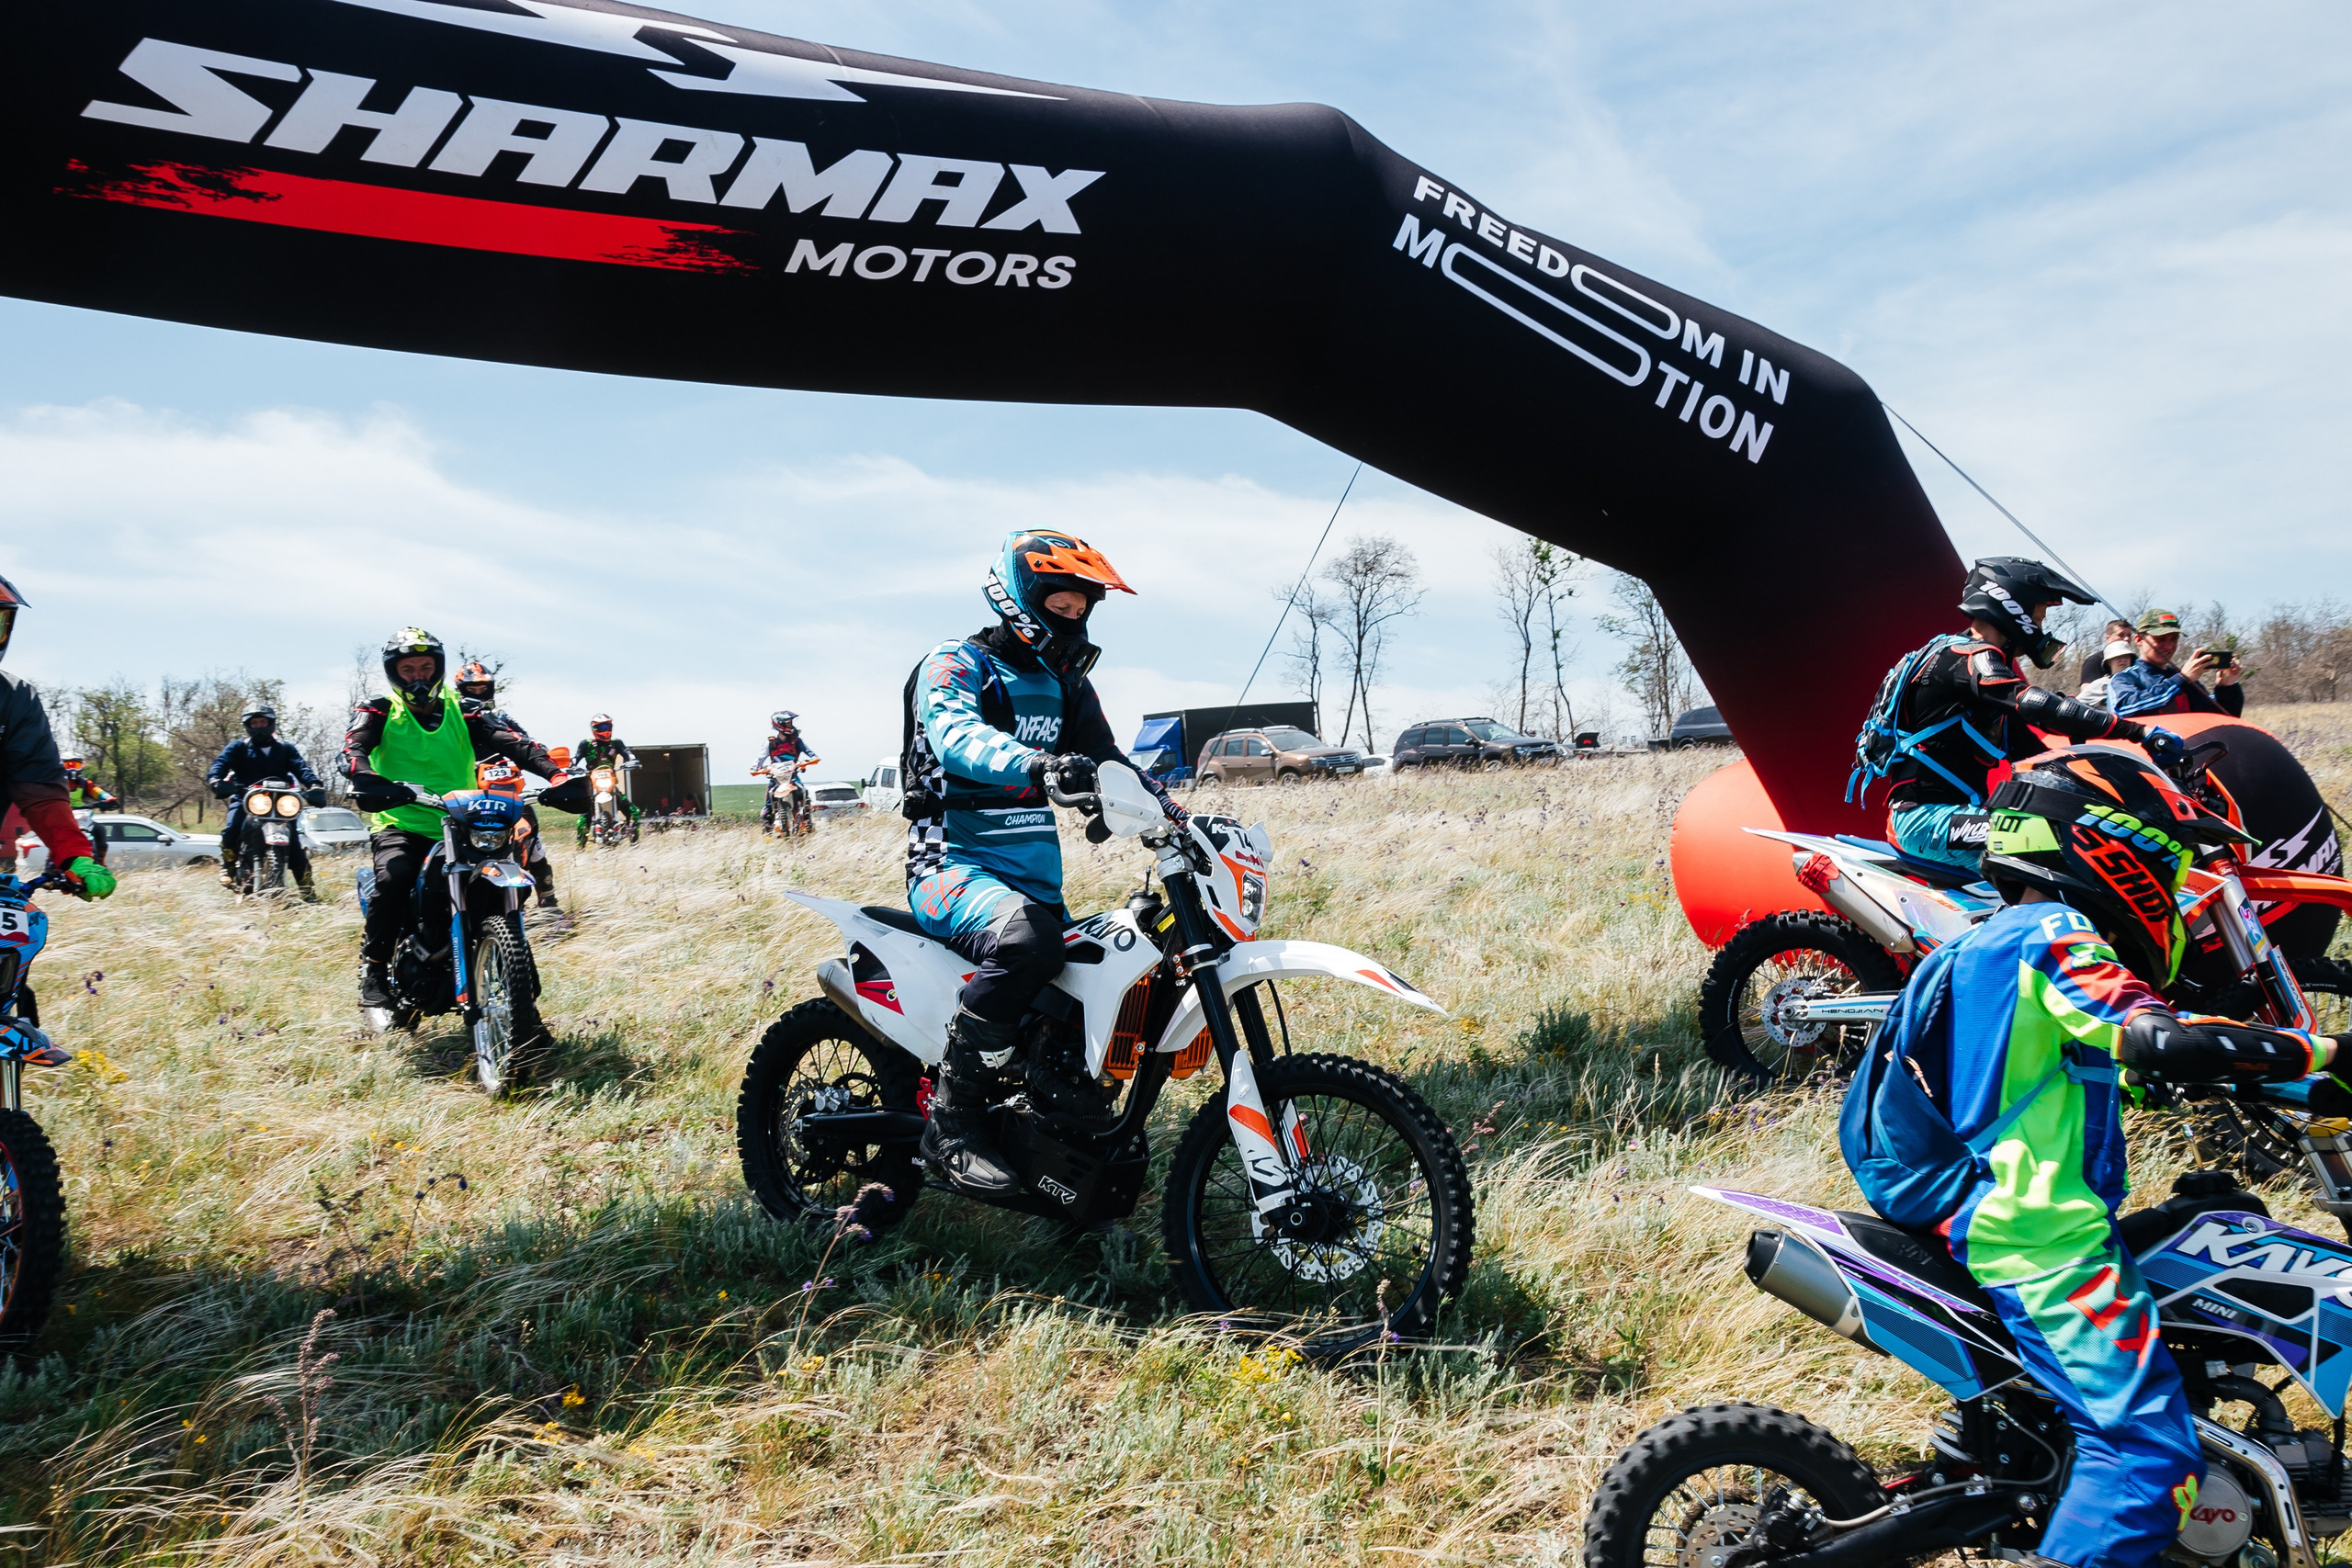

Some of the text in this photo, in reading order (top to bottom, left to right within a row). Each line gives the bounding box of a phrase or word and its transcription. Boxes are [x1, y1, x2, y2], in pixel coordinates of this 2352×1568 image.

[80, 37, 1106, 234] SHARMAX
[784, 239, 1076, 289] MOTORS
[1413, 175, 1790, 406] FREEDOM IN
[1392, 213, 1774, 464] MOTION
[1980, 580, 2039, 635] 100%
[488, 769, 507, 778] 129
[467, 799, 507, 811] KTR
[1004, 813, 1046, 826] CHAMPION
[2075, 803, 2183, 871] 100%
[1077, 916, 1137, 953] KAYO
[2191, 1297, 2239, 1320] MINI
